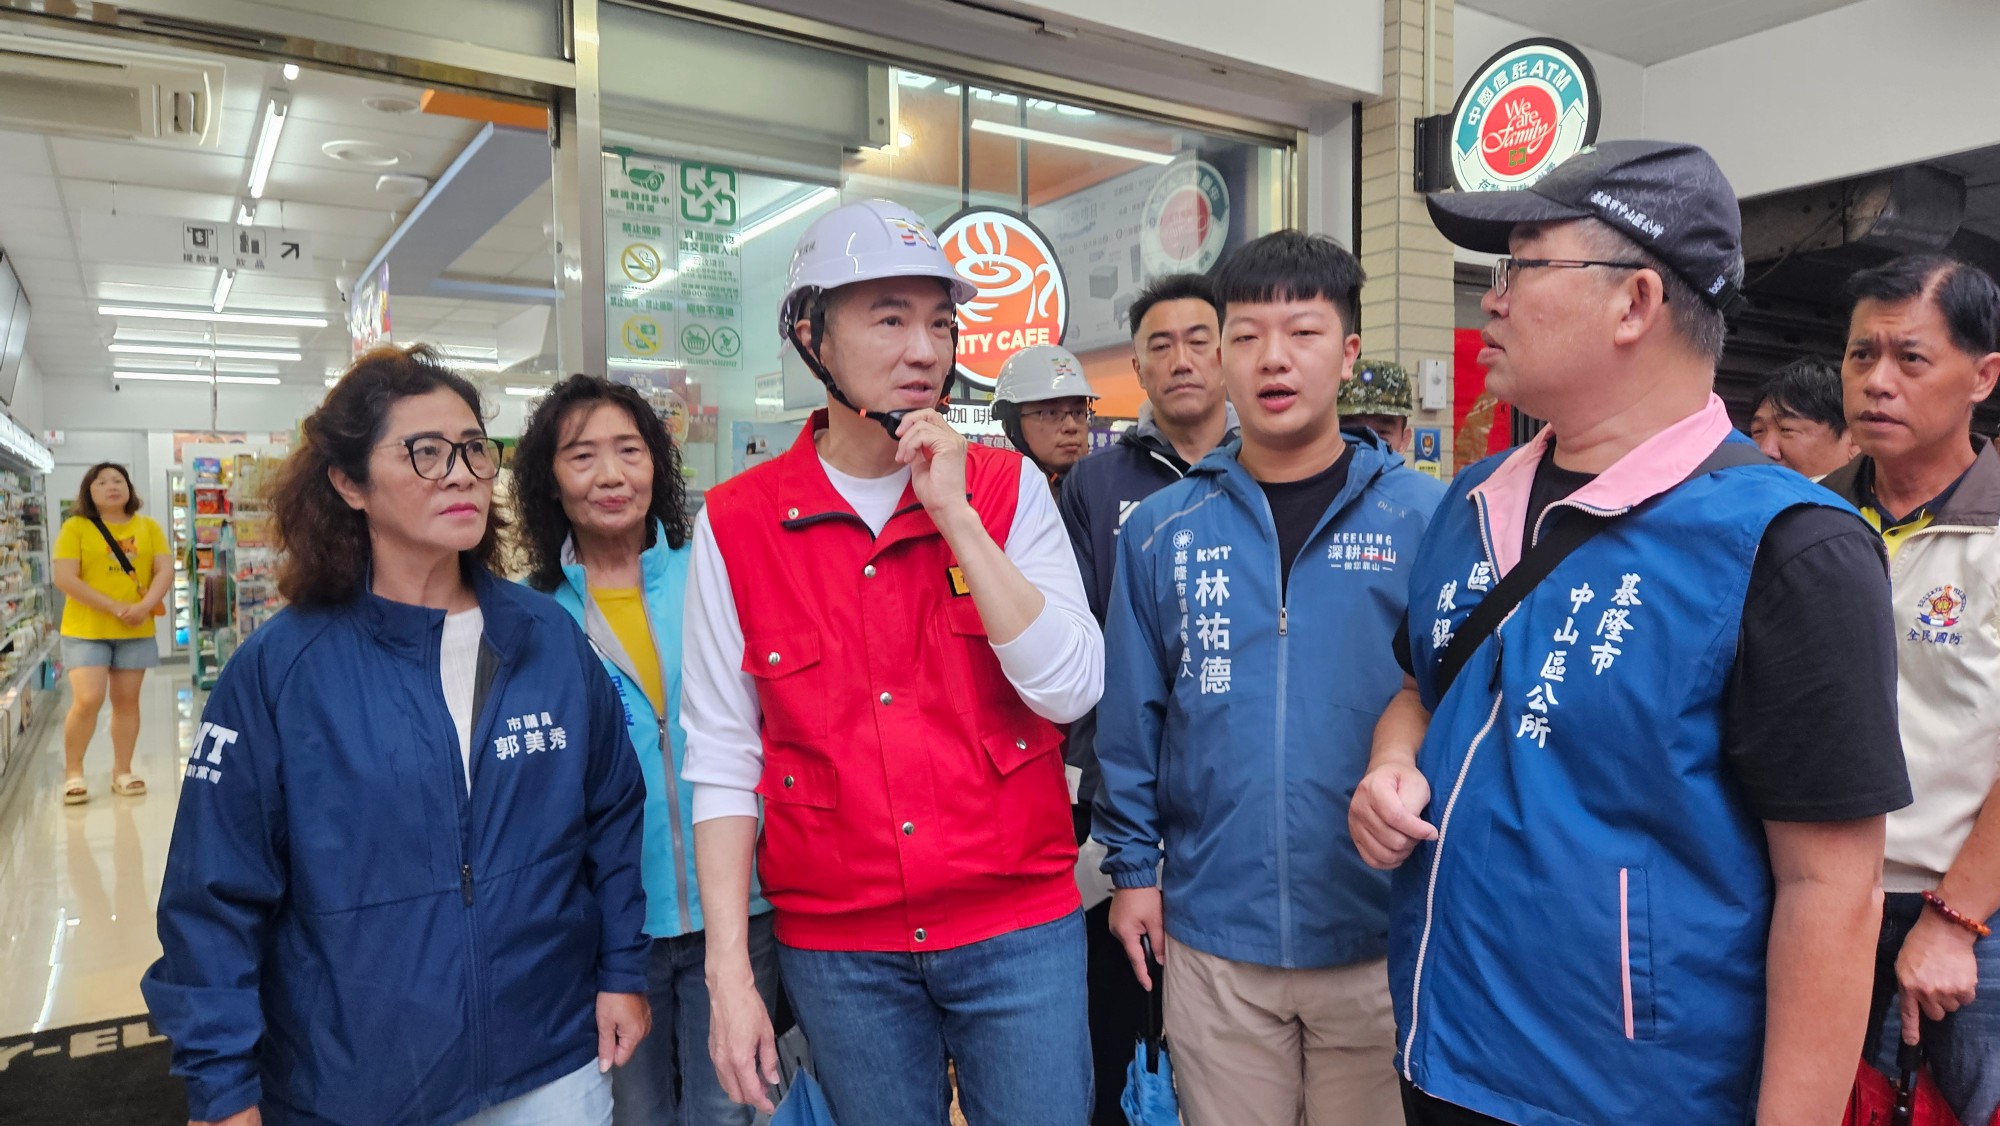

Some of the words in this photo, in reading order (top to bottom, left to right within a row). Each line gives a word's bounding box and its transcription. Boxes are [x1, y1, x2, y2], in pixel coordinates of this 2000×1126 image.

[1505, 97, 1531, 118] We
[1515, 110, 1539, 128] are
[1482, 112, 1558, 155] Family
[957, 332, 994, 355] ITY
[996, 327, 1050, 351] CAFE
[1333, 532, 1392, 546] KEELUNG
[1196, 545, 1232, 562] KMT
[1327, 544, 1397, 565] 深耕中山
[1467, 560, 1492, 592] 區
[1431, 579, 1458, 650] 陳錫
[1590, 572, 1642, 676] 基隆市
[1194, 568, 1232, 695] 林祐德
[1906, 627, 1963, 646] 全民國防
[1516, 582, 1595, 748] 中山區公所
[506, 711, 553, 732] 市議員
[493, 726, 567, 761] 郭美秀
